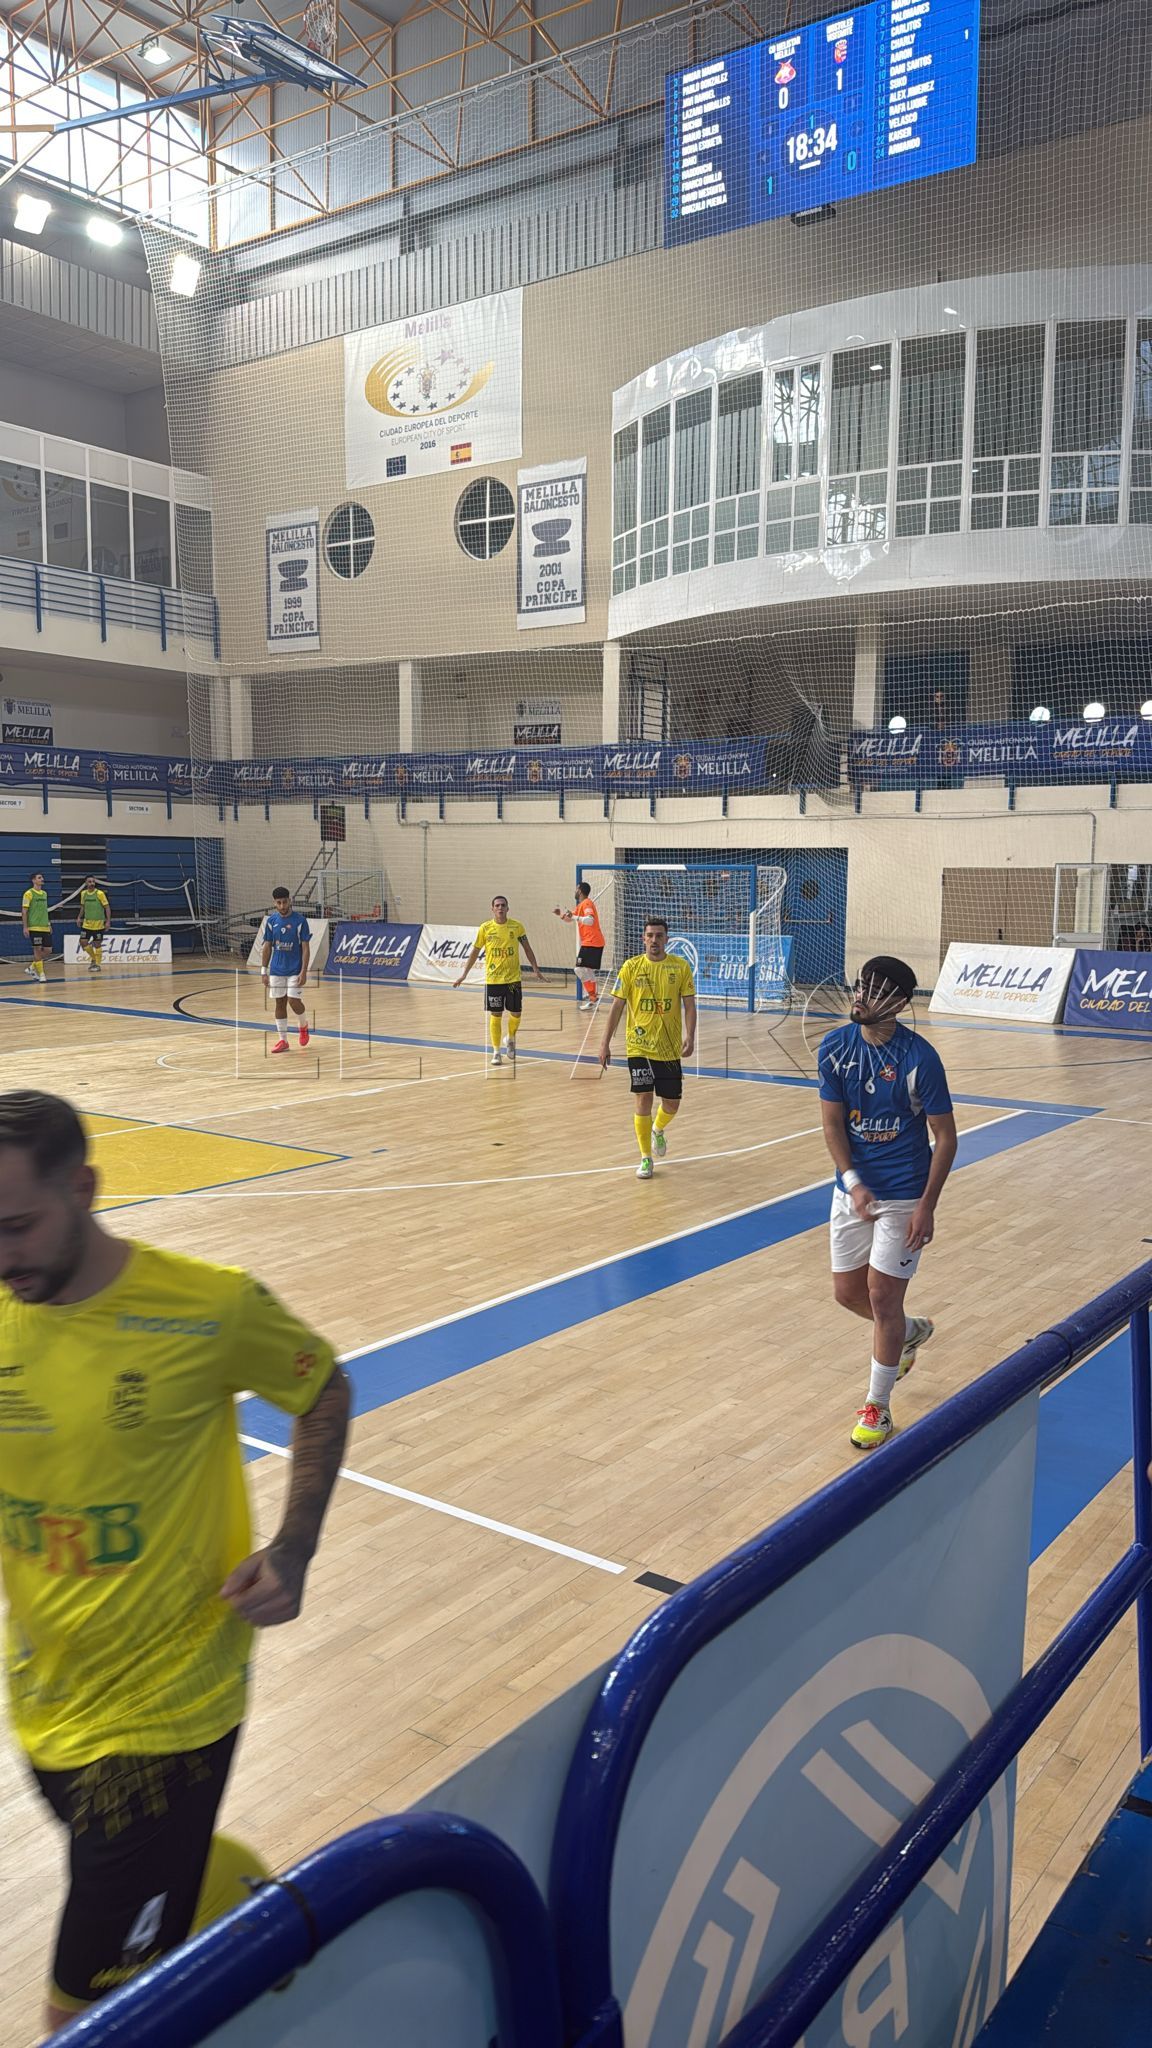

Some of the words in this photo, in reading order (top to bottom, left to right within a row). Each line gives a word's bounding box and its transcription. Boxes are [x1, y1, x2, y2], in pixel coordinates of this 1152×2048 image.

[836, 68, 843, 91] 1
[778, 87, 789, 110] 0
[786, 123, 838, 164] 18:34
[847, 150, 857, 171] 0
[766, 176, 773, 196] 1
[404, 311, 452, 339] Melilla
[379, 426, 404, 439] CIUDAD
[404, 419, 434, 434] EUROPEA
[434, 417, 447, 428] DEL
[447, 409, 479, 425] DEPORTE
[391, 432, 423, 447] EUROPEAN
[423, 430, 438, 441] CITY
[436, 428, 446, 437] OF
[446, 423, 467, 436] SPORT
[419, 439, 436, 451] 2016
[525, 481, 578, 501] MELILLA
[523, 493, 580, 514] BALONCESTO
[272, 527, 313, 543] MELILLA
[271, 537, 315, 554] BALONCESTO
[539, 561, 562, 578] 2001
[536, 578, 566, 594] COPA
[284, 596, 302, 610] 1999
[525, 589, 578, 607] PRINCIPE
[282, 610, 305, 623] COPA
[273, 620, 315, 635] PRINCIPE
[17, 705, 52, 718] MELILLA
[5, 726, 51, 741] MELILLA
[516, 724, 560, 740] MELILLA
[1052, 724, 1139, 750] MELILLA
[852, 734, 923, 759] MELILLA
[967, 738, 994, 746] CIUDAD
[24, 751, 80, 771] MELILLA
[603, 751, 662, 770] MELILLA
[969, 744, 1038, 763] MELILLA
[342, 761, 386, 778] MELILLA
[465, 755, 516, 775] MELILLA
[547, 766, 595, 780] MELILLA
[696, 760, 751, 777] MELILLA
[113, 770, 159, 783] MELILLA
[298, 774, 335, 787] MELILLA
[412, 770, 455, 783] MELILLA
[336, 933, 412, 957] MELILLA
[127, 954, 160, 962] DEPORTE
[333, 955, 359, 964] CIUDAD
[359, 956, 372, 966] DEL
[372, 957, 402, 967] DEPORTE
[759, 965, 785, 981] SALA
[956, 963, 1053, 992] MELILLA
[953, 988, 983, 998] CIUDAD
[984, 989, 1001, 999] DEL
[1002, 991, 1040, 1003] DEPORTE
[1080, 998, 1126, 1012] CIUDAD
[1127, 1001, 1151, 1013] DEL
[864, 1076, 876, 1095] 6
[122, 1890, 169, 1954] 4
